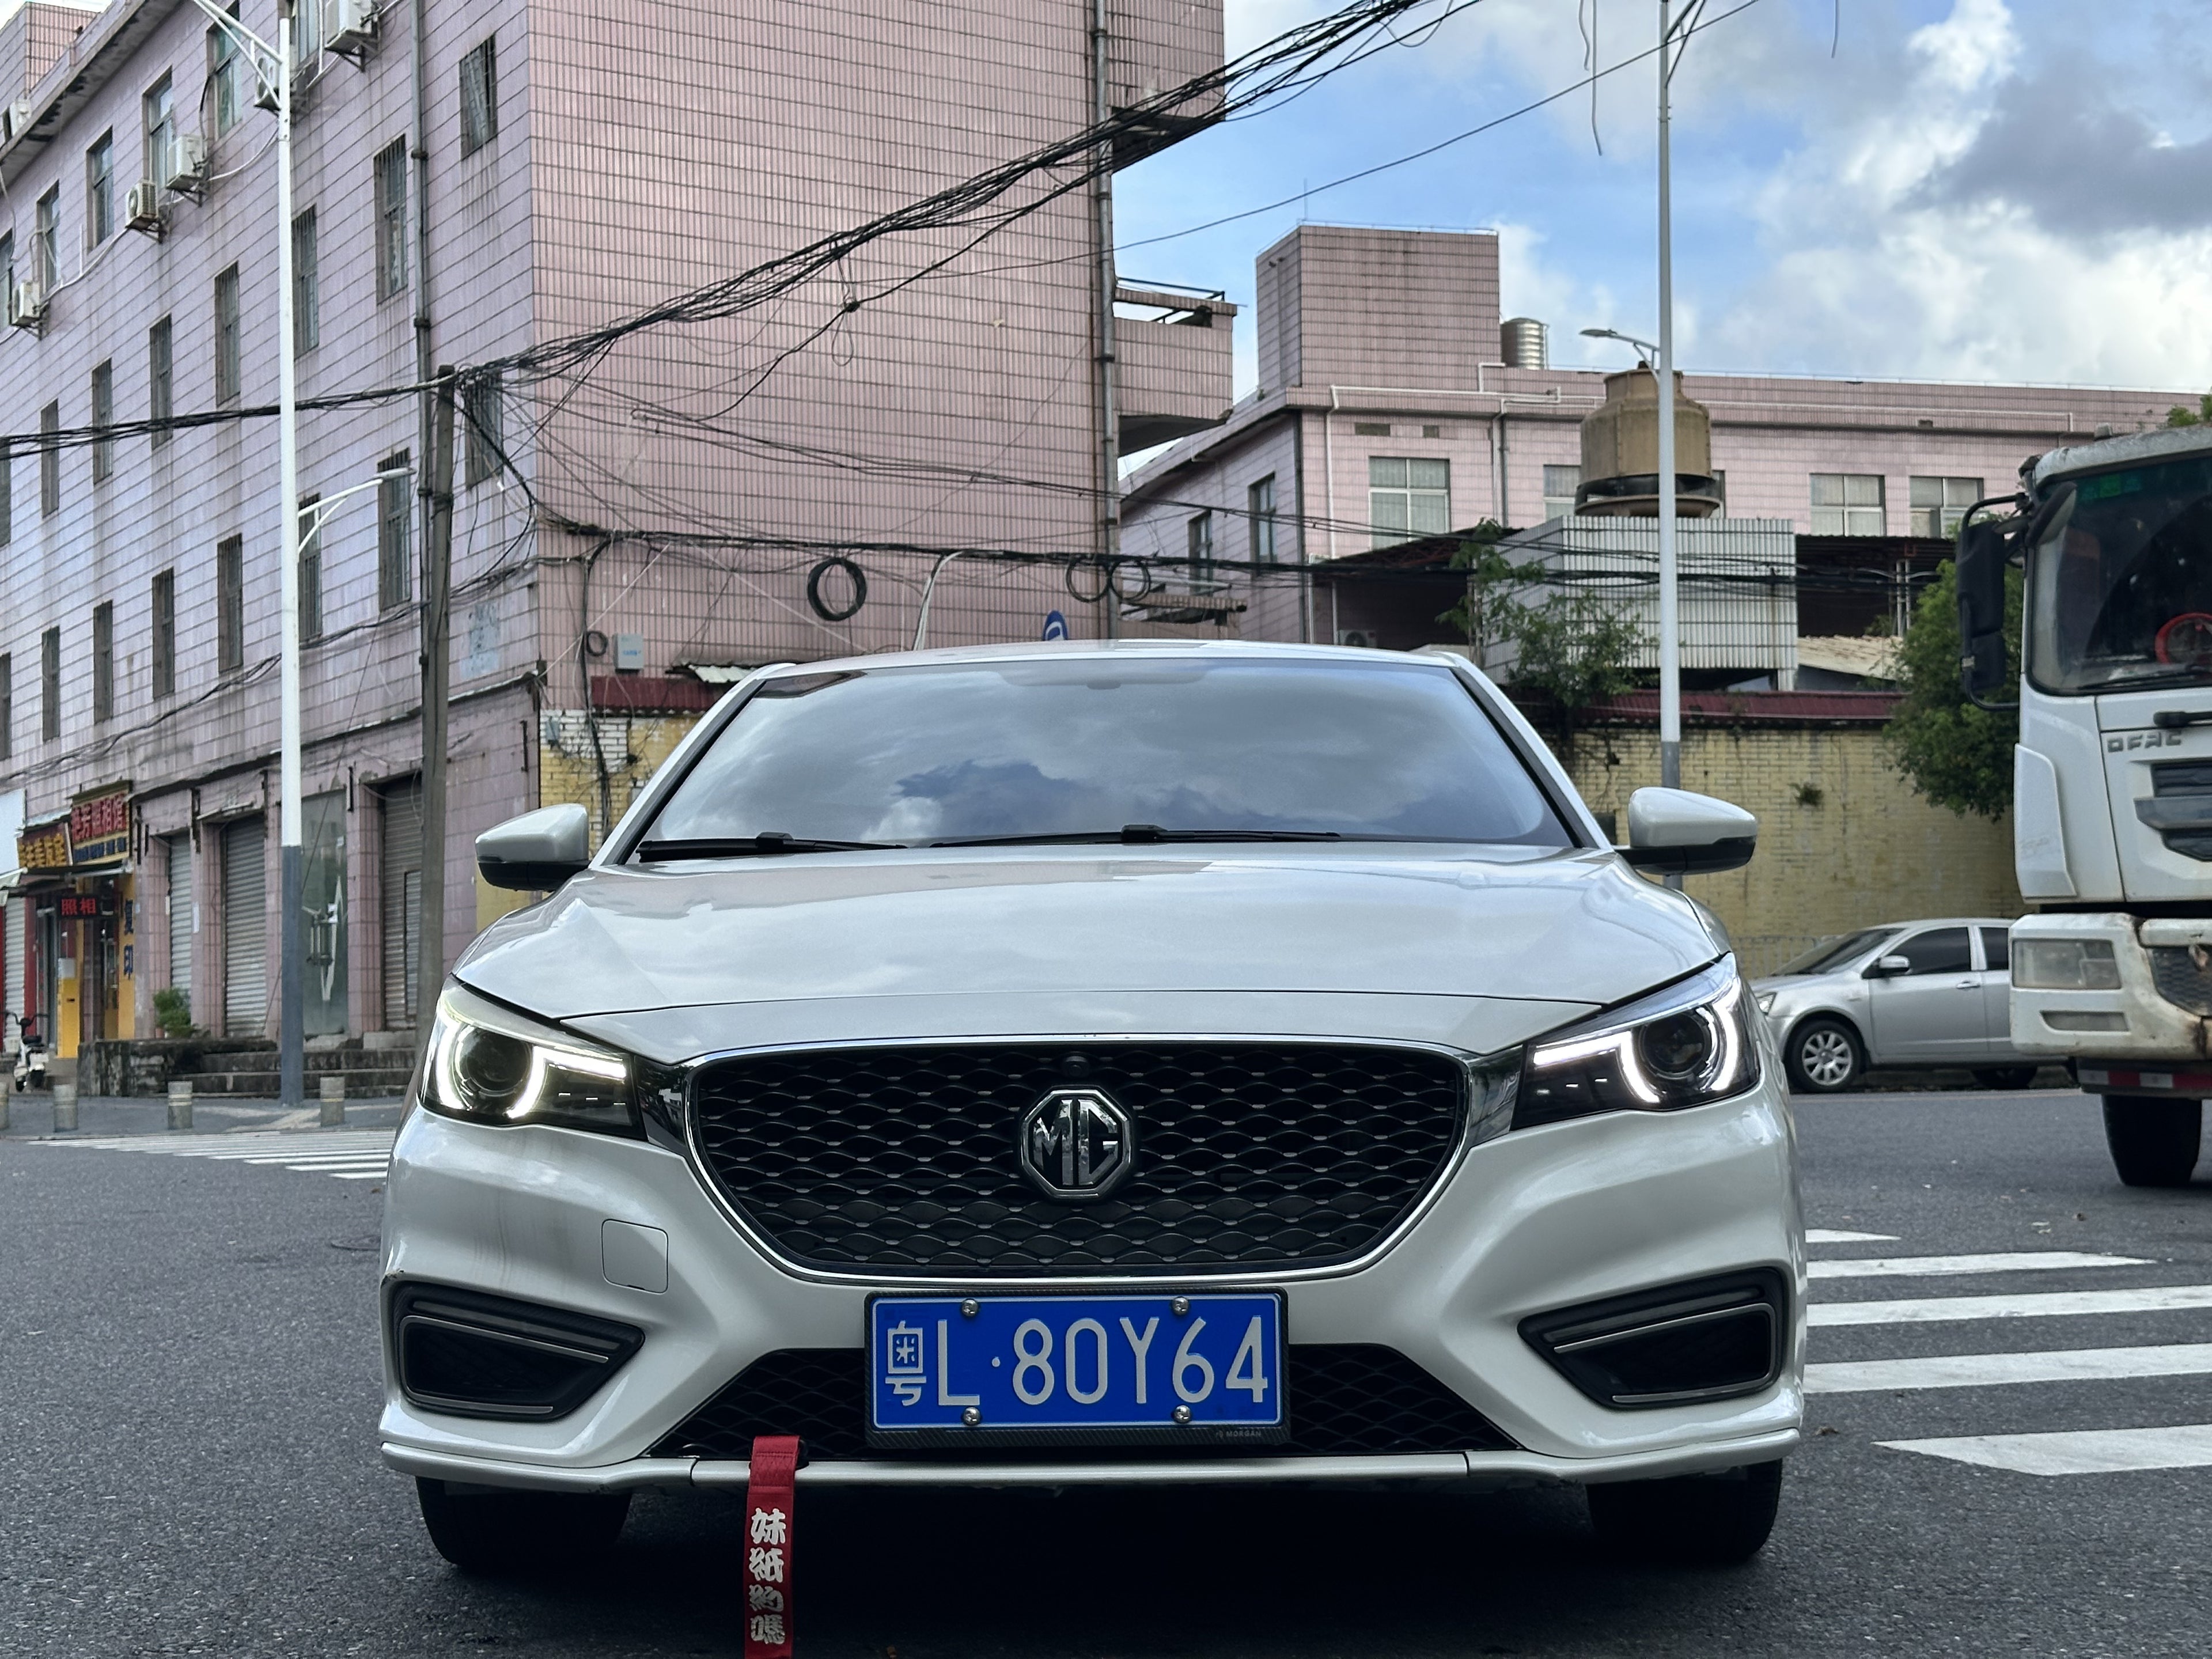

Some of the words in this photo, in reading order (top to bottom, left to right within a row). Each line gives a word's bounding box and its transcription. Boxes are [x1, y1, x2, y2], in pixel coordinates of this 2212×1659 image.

[61, 898, 97, 916] 照相
[123, 899, 134, 981] 复印
[1033, 1099, 1119, 1186] MG
